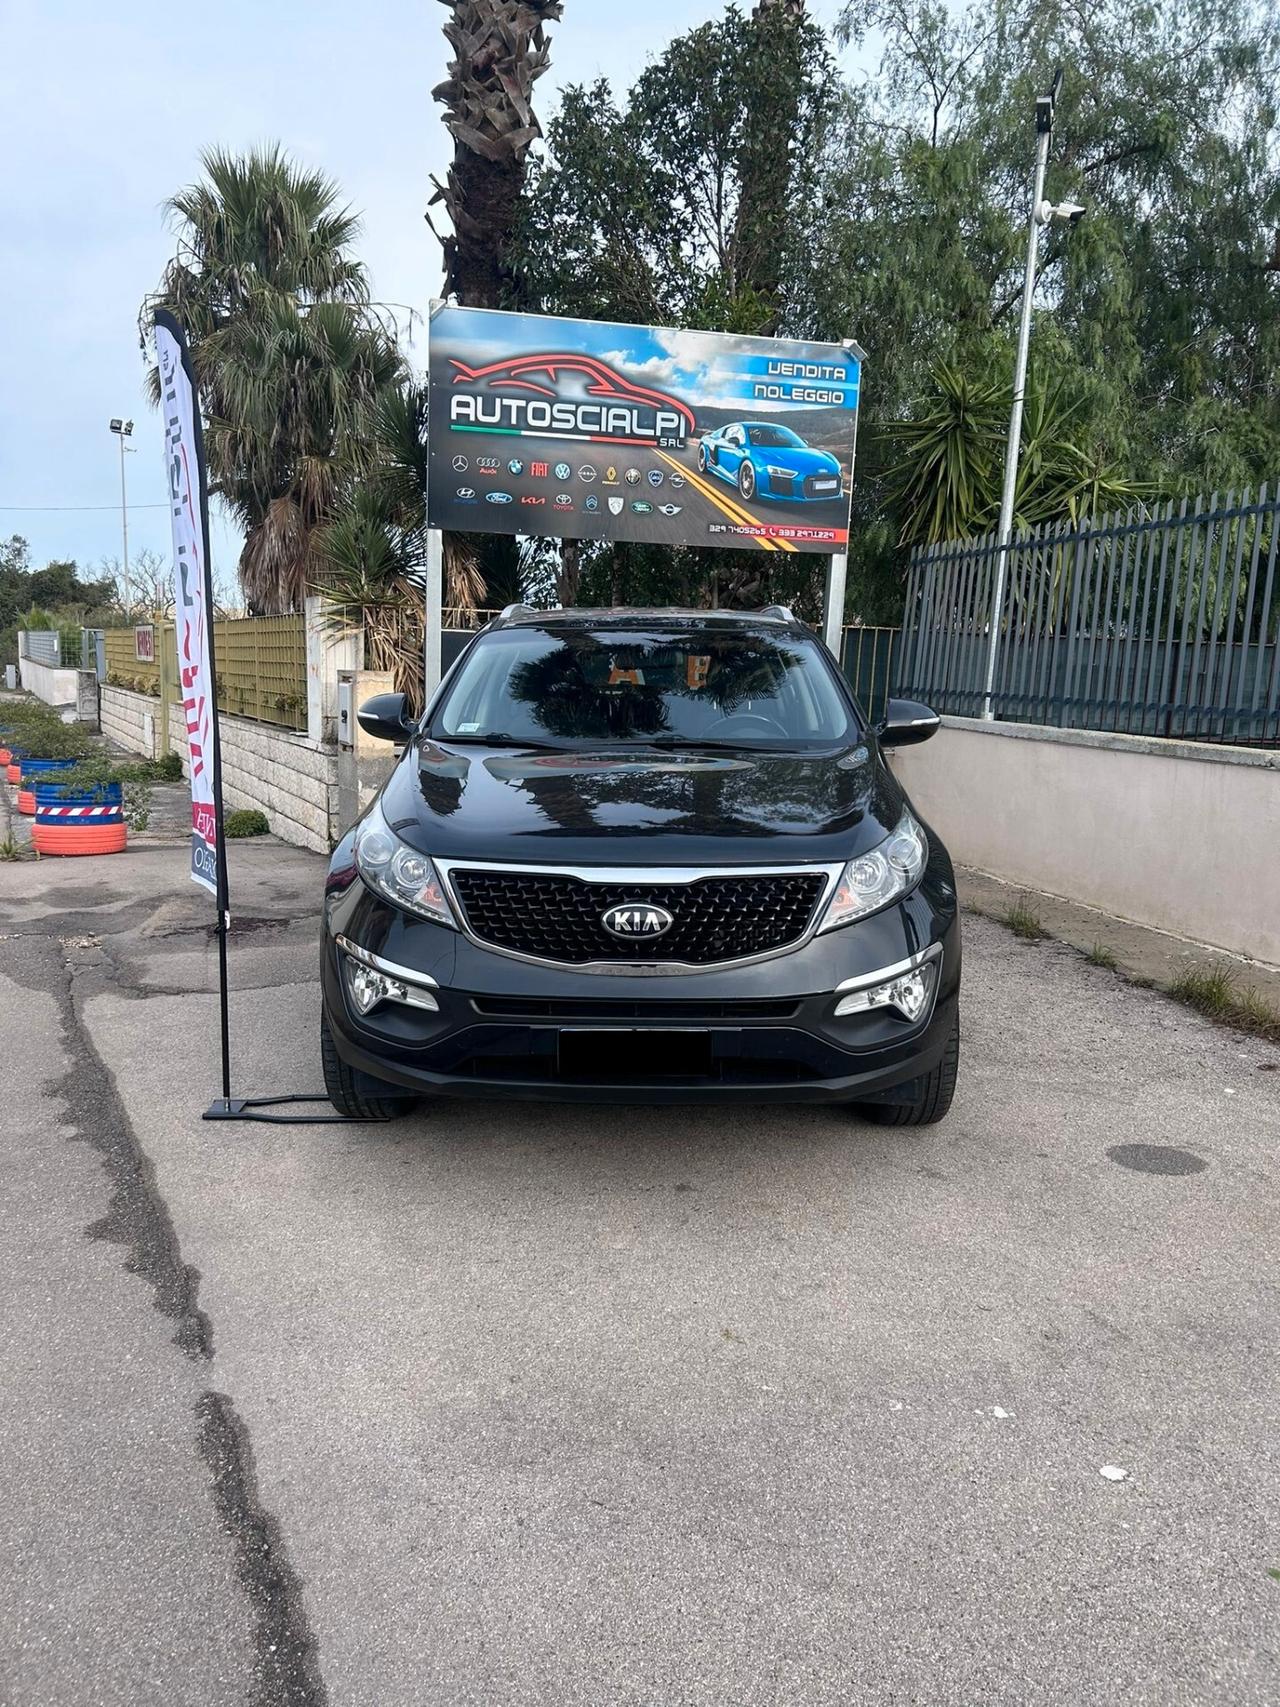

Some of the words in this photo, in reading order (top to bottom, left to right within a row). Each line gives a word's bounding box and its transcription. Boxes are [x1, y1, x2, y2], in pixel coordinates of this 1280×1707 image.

[768, 361, 846, 380] VENDITA
[755, 384, 844, 404] NOLEGGIO
[450, 394, 685, 438] AUTOSCIALPI
[659, 438, 684, 448] SRL
[531, 463, 548, 477] FIAT
[709, 524, 727, 533] 329
[614, 911, 661, 931] KIA
